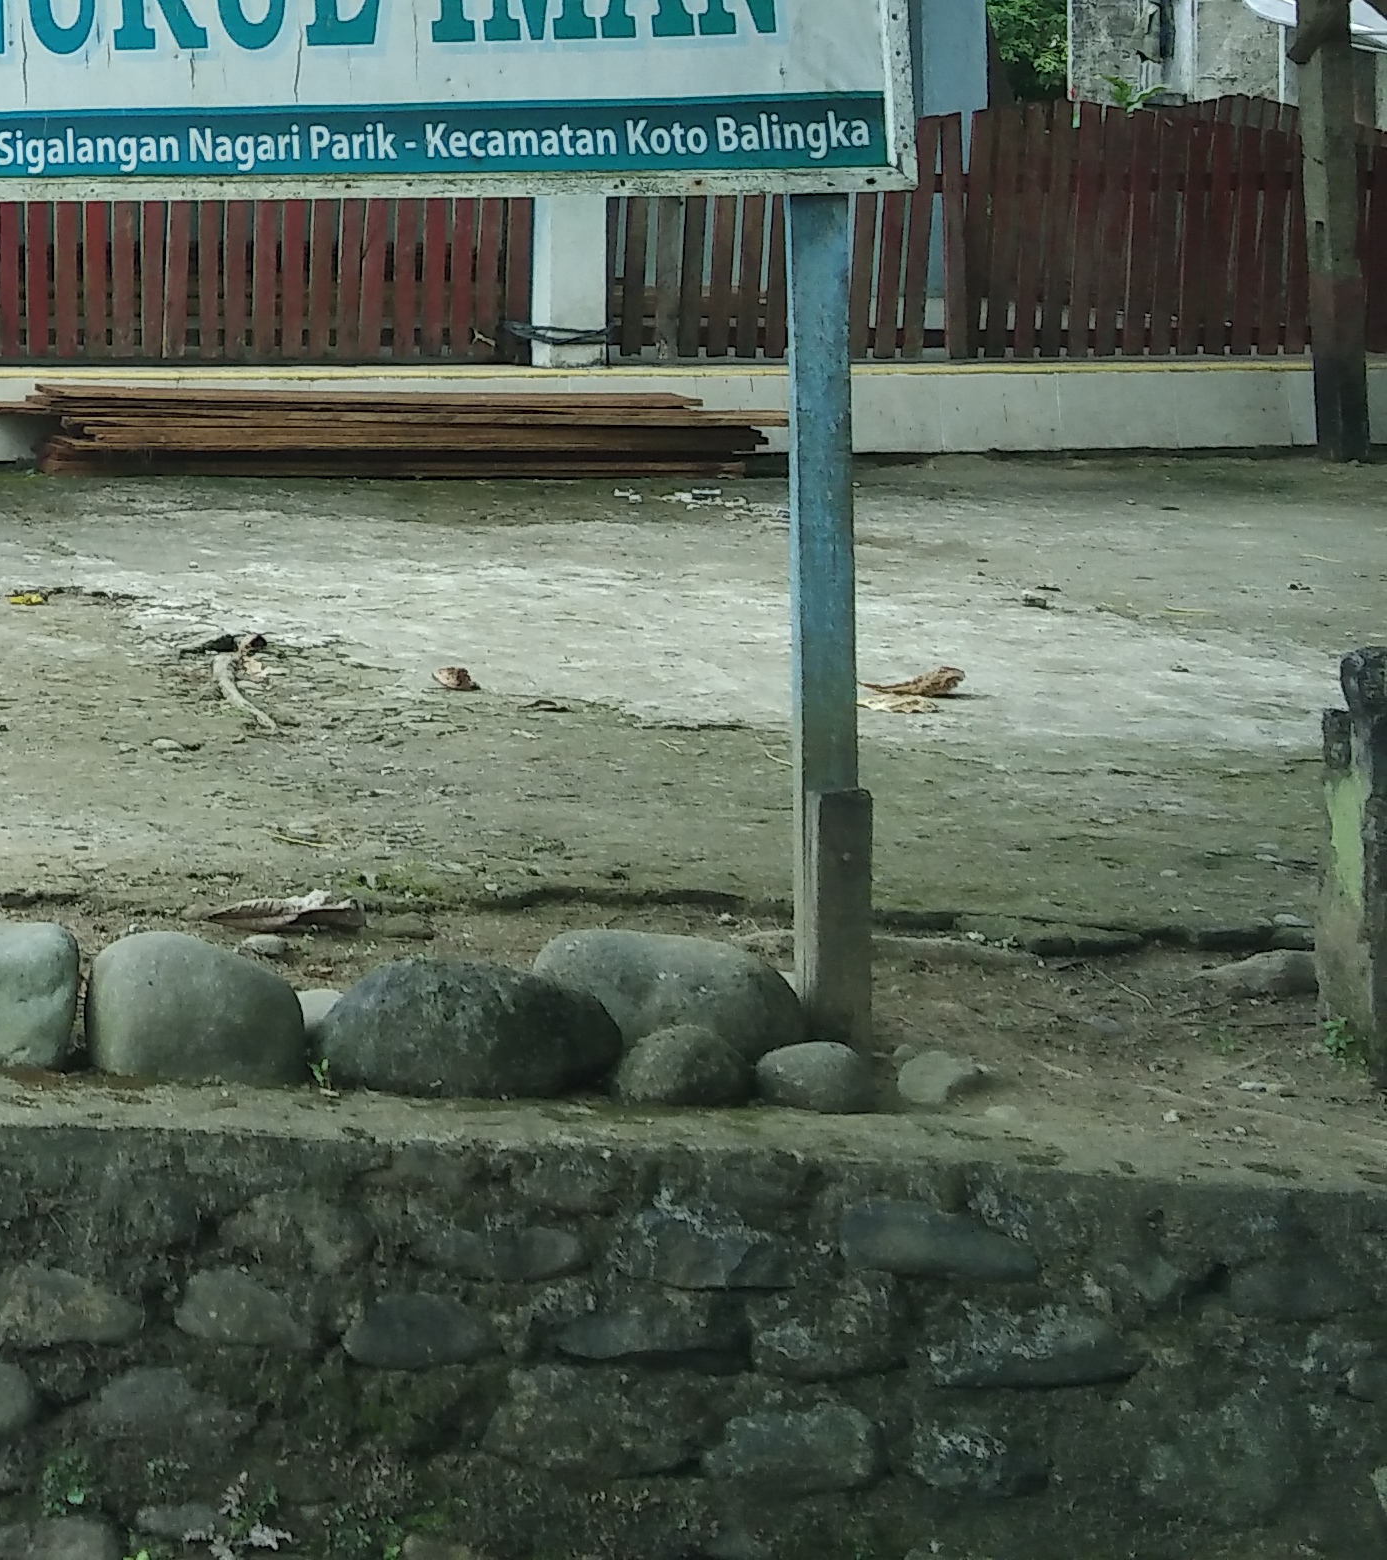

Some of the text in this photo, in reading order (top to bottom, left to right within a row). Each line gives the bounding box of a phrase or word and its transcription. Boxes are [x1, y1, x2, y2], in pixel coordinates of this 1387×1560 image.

[189, 125, 300, 171] Nagari
[311, 122, 396, 161] Parik
[425, 123, 617, 158] Kecamatan
[626, 119, 708, 156] Koto
[716, 111, 870, 160] Balingka
